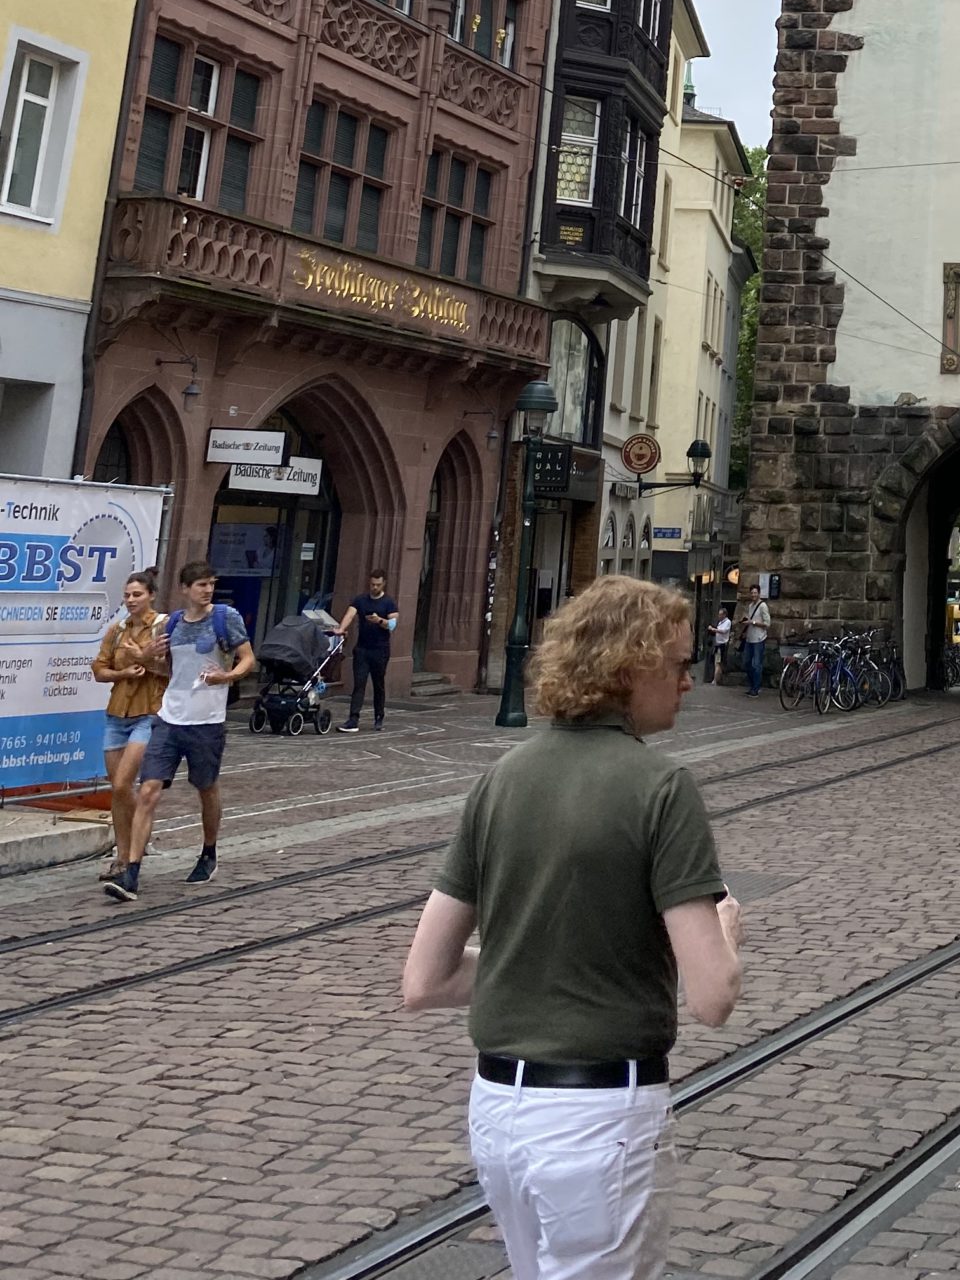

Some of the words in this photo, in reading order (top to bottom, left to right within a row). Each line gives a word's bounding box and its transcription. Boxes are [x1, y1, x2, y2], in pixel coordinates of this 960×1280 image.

[211, 440, 243, 451] Badische
[253, 442, 281, 454] Zeitung
[234, 465, 273, 479] Badische
[286, 465, 318, 487] Zeitung
[46, 606, 58, 620] SIE
[60, 606, 90, 620] BESSER
[90, 606, 102, 620] AB
[45, 671, 93, 682] Entkernung
[43, 686, 78, 697] Rückbau
